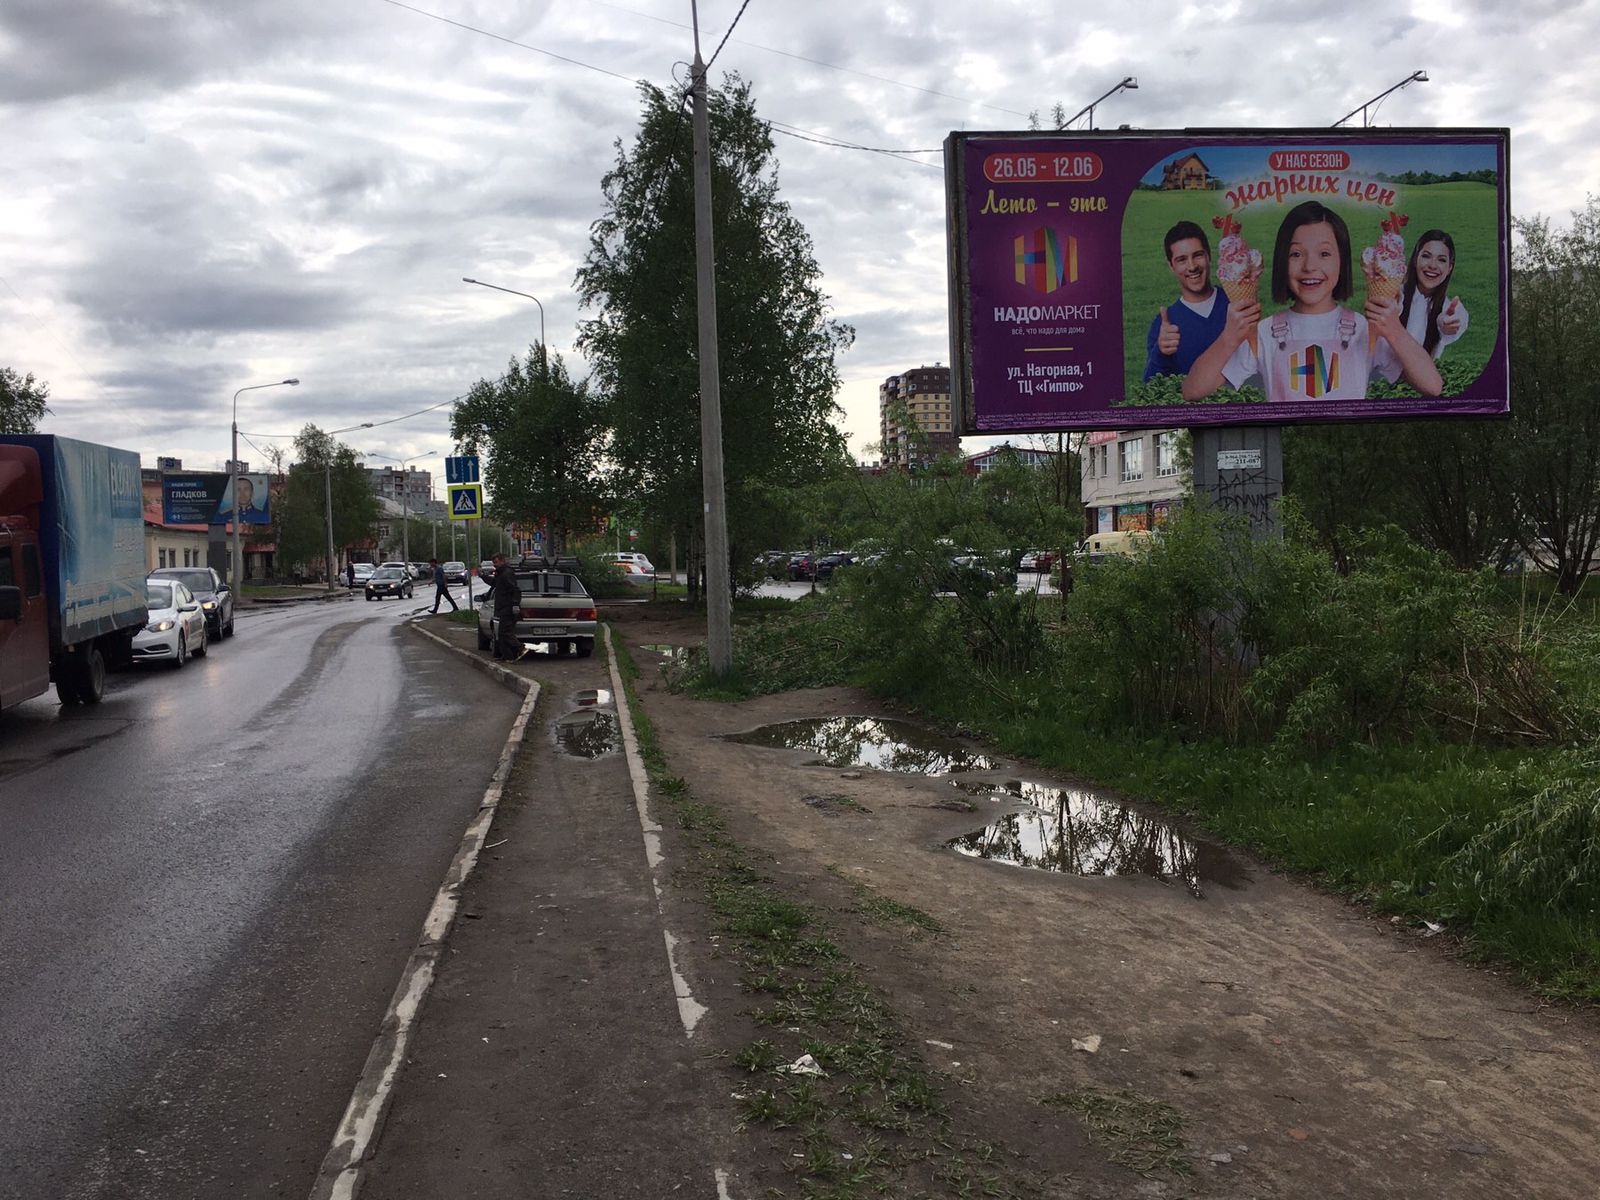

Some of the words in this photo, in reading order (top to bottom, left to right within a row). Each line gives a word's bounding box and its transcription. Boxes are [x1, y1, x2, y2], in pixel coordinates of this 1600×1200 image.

[993, 158, 1037, 177] 26.05
[1053, 156, 1093, 177] 12.06
[1276, 153, 1284, 168] У
[1286, 153, 1307, 168] НАС
[1309, 153, 1343, 168] СЕЗОН
[1225, 174, 1340, 209] жарких
[1346, 179, 1396, 206] цен
[981, 189, 1038, 214] Лето
[1069, 197, 1108, 213] это
[994, 305, 1100, 324] НАДОМАРКЕТ
[1011, 327, 1025, 336] всё,
[1039, 327, 1053, 335] надо
[1055, 327, 1067, 335] для
[1068, 327, 1085, 335] дома
[1007, 367, 1024, 380] ул.
[1026, 363, 1084, 379] Нагорная,
[1086, 361, 1093, 375] 1
[1017, 380, 1033, 395] ТЦ
[1035, 379, 1084, 393] «Гиппо»
[171, 491, 207, 499] ГЛАДКОВ
